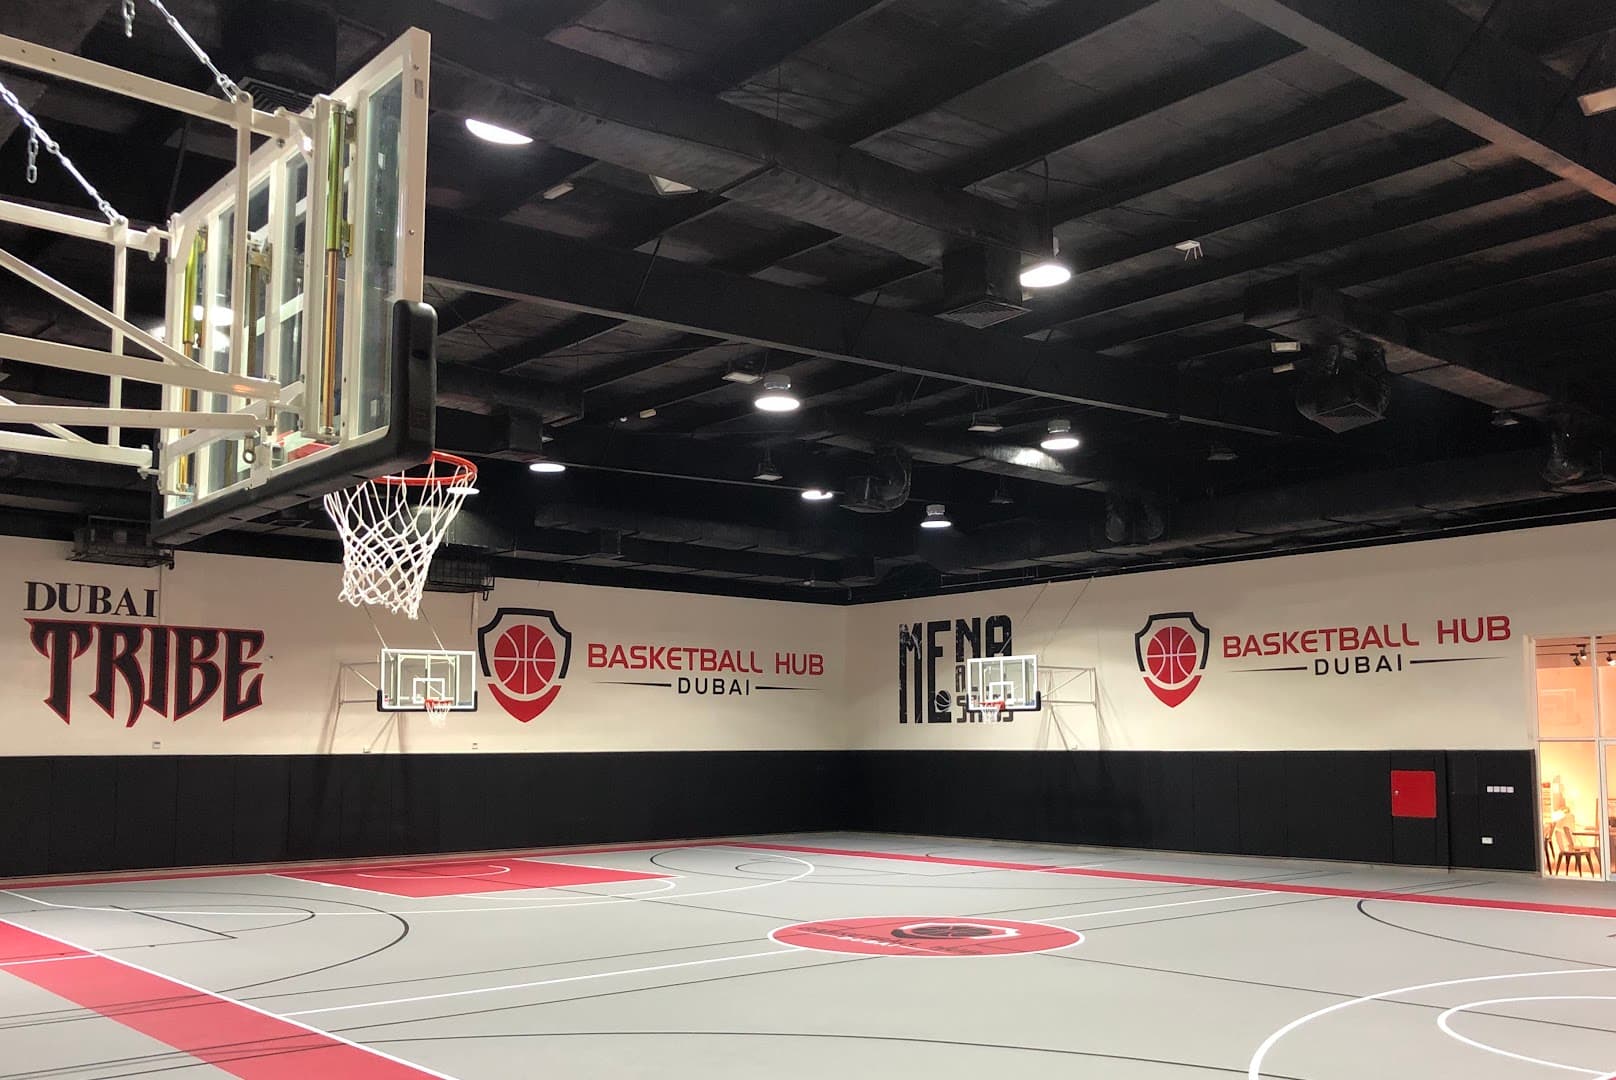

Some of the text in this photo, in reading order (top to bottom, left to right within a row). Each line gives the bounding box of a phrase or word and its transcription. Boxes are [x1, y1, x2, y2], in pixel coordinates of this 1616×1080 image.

[24, 581, 159, 618] DUBAI
[1222, 614, 1512, 659] BASKETBALL HUB
[24, 617, 265, 728] TRIBE
[587, 643, 825, 676] BASKETBALL HUB
[1314, 653, 1403, 676] DUBAI
[677, 677, 750, 696] DUBAI
